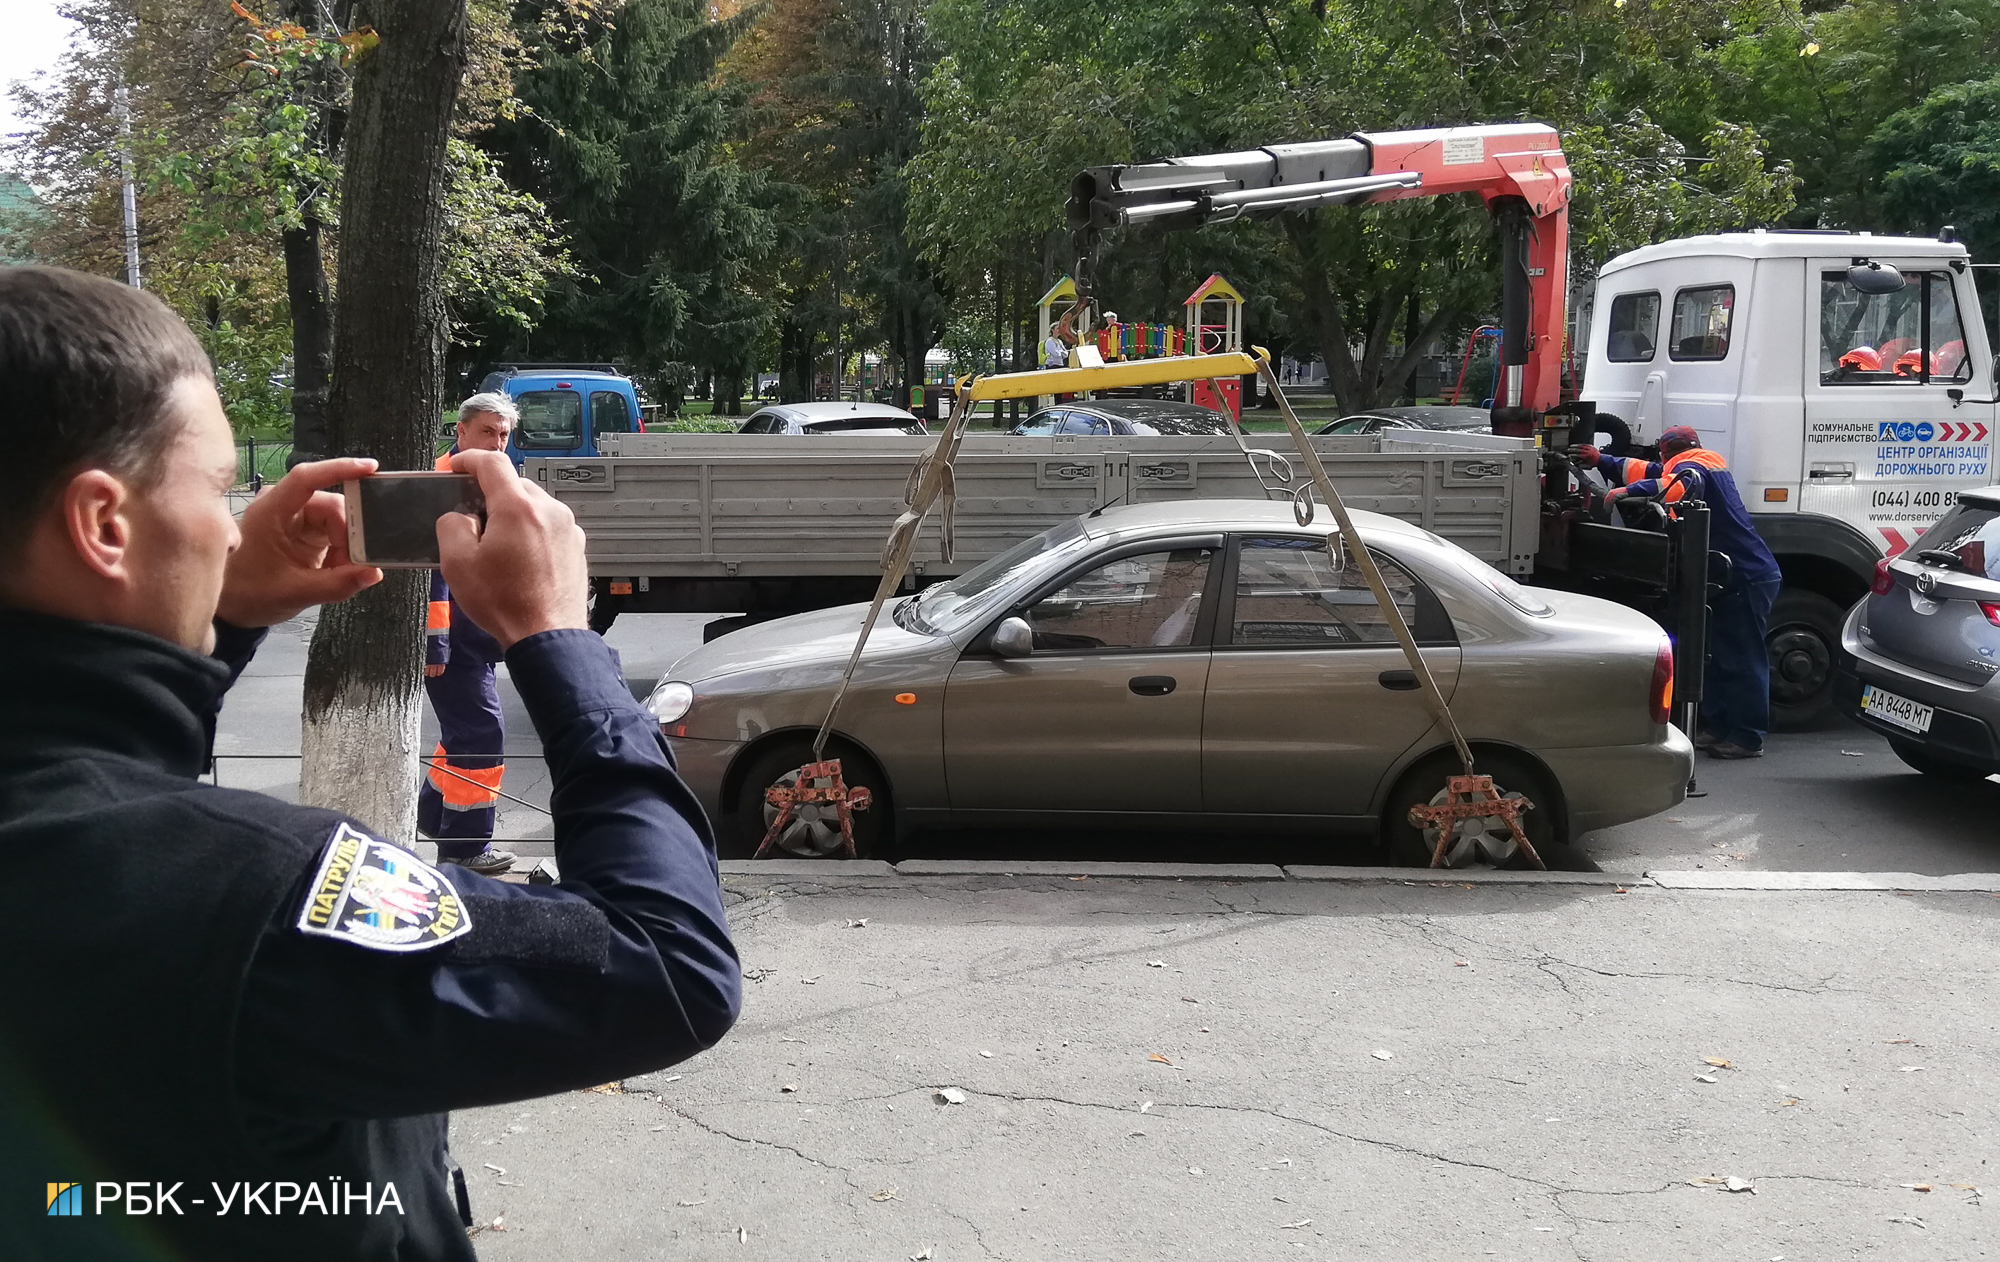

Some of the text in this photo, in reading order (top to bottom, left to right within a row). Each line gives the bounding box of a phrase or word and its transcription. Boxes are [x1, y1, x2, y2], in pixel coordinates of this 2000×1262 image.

[1812, 423, 1874, 432] КОМУНАЛЬНЕ
[1808, 434, 1878, 443] ПІДПРИЄМСТВО
[1877, 443, 1989, 460] ЦЕНТР ОРГАНІЗАЦІЇ
[1875, 463, 1988, 477] ДОРОЖНЬОГО РУХУ
[1872, 490, 1909, 507] (044)
[1913, 491, 1940, 506] 400
[1886, 696, 1912, 720] 8448
[1912, 705, 1931, 727] MT
[308, 838, 361, 924] ПАТРУЛЬ
